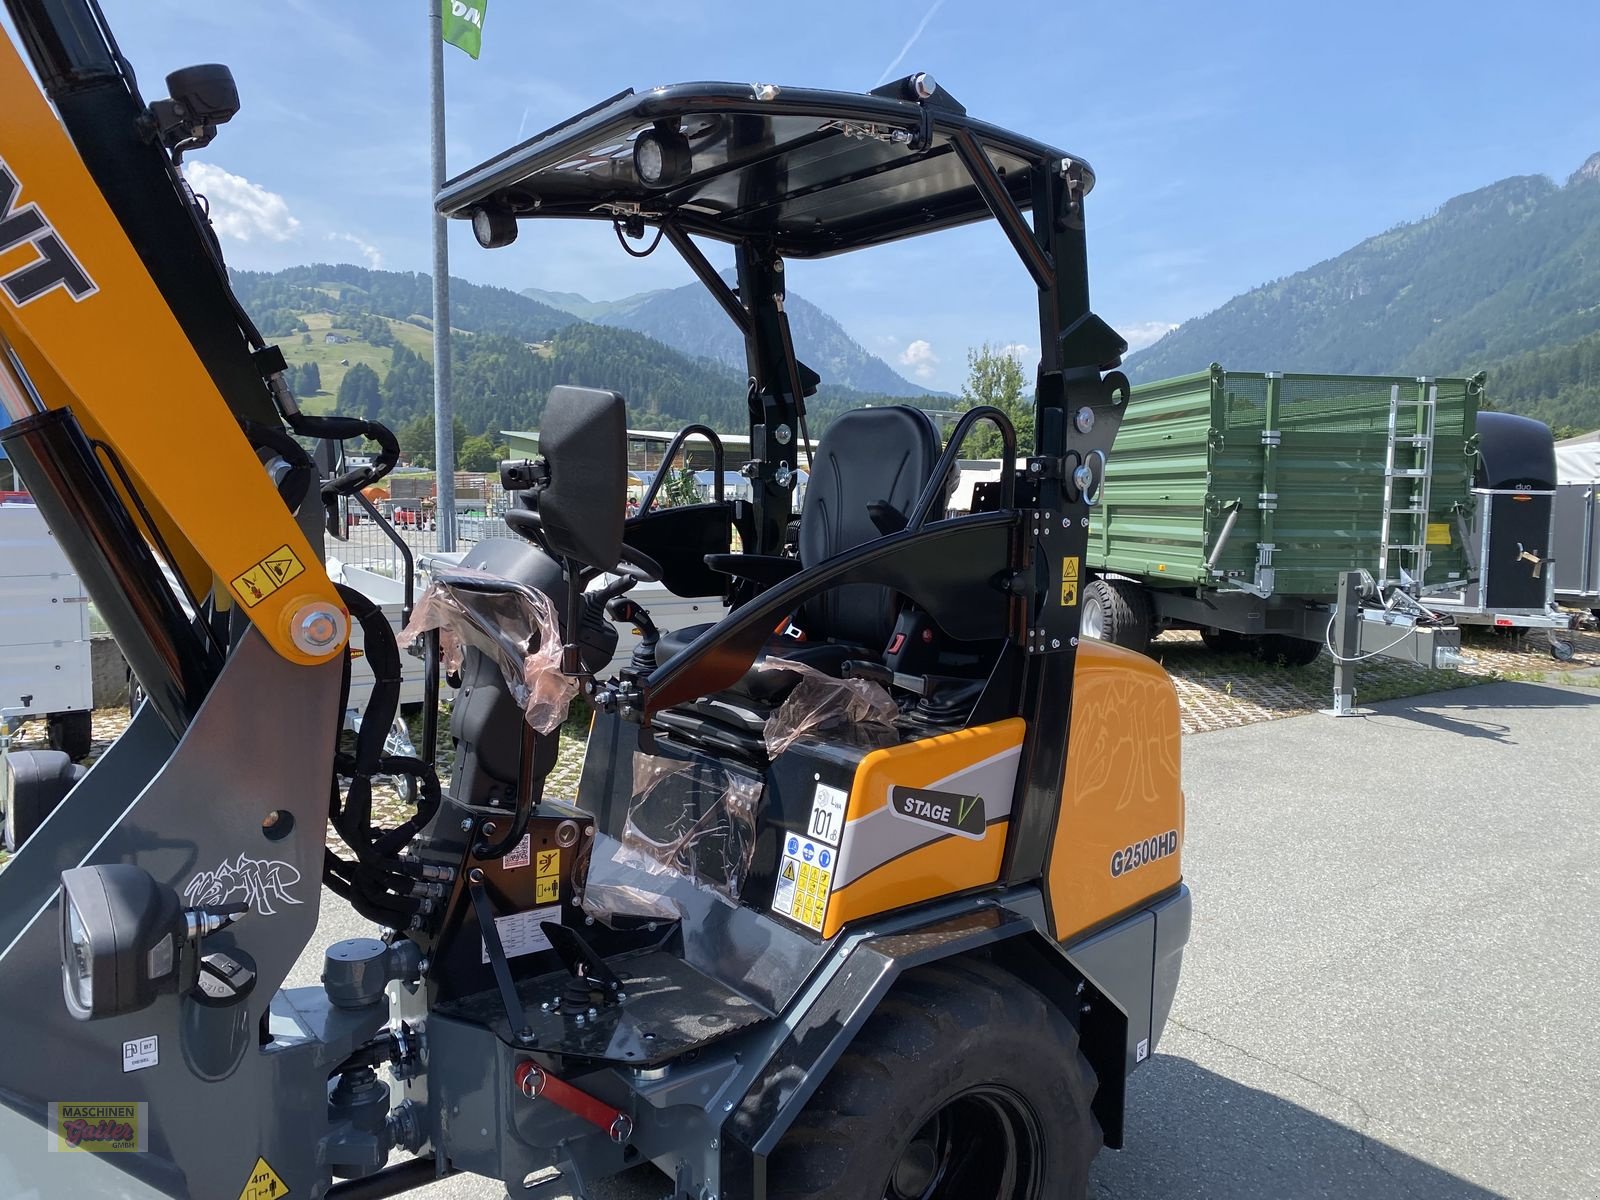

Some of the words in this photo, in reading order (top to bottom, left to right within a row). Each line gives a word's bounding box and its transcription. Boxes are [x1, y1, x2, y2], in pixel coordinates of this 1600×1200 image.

[812, 807, 833, 839] 101
[904, 797, 951, 823] STAGE
[1110, 829, 1178, 878] G2500HD
[251, 1172, 270, 1184] 4m
